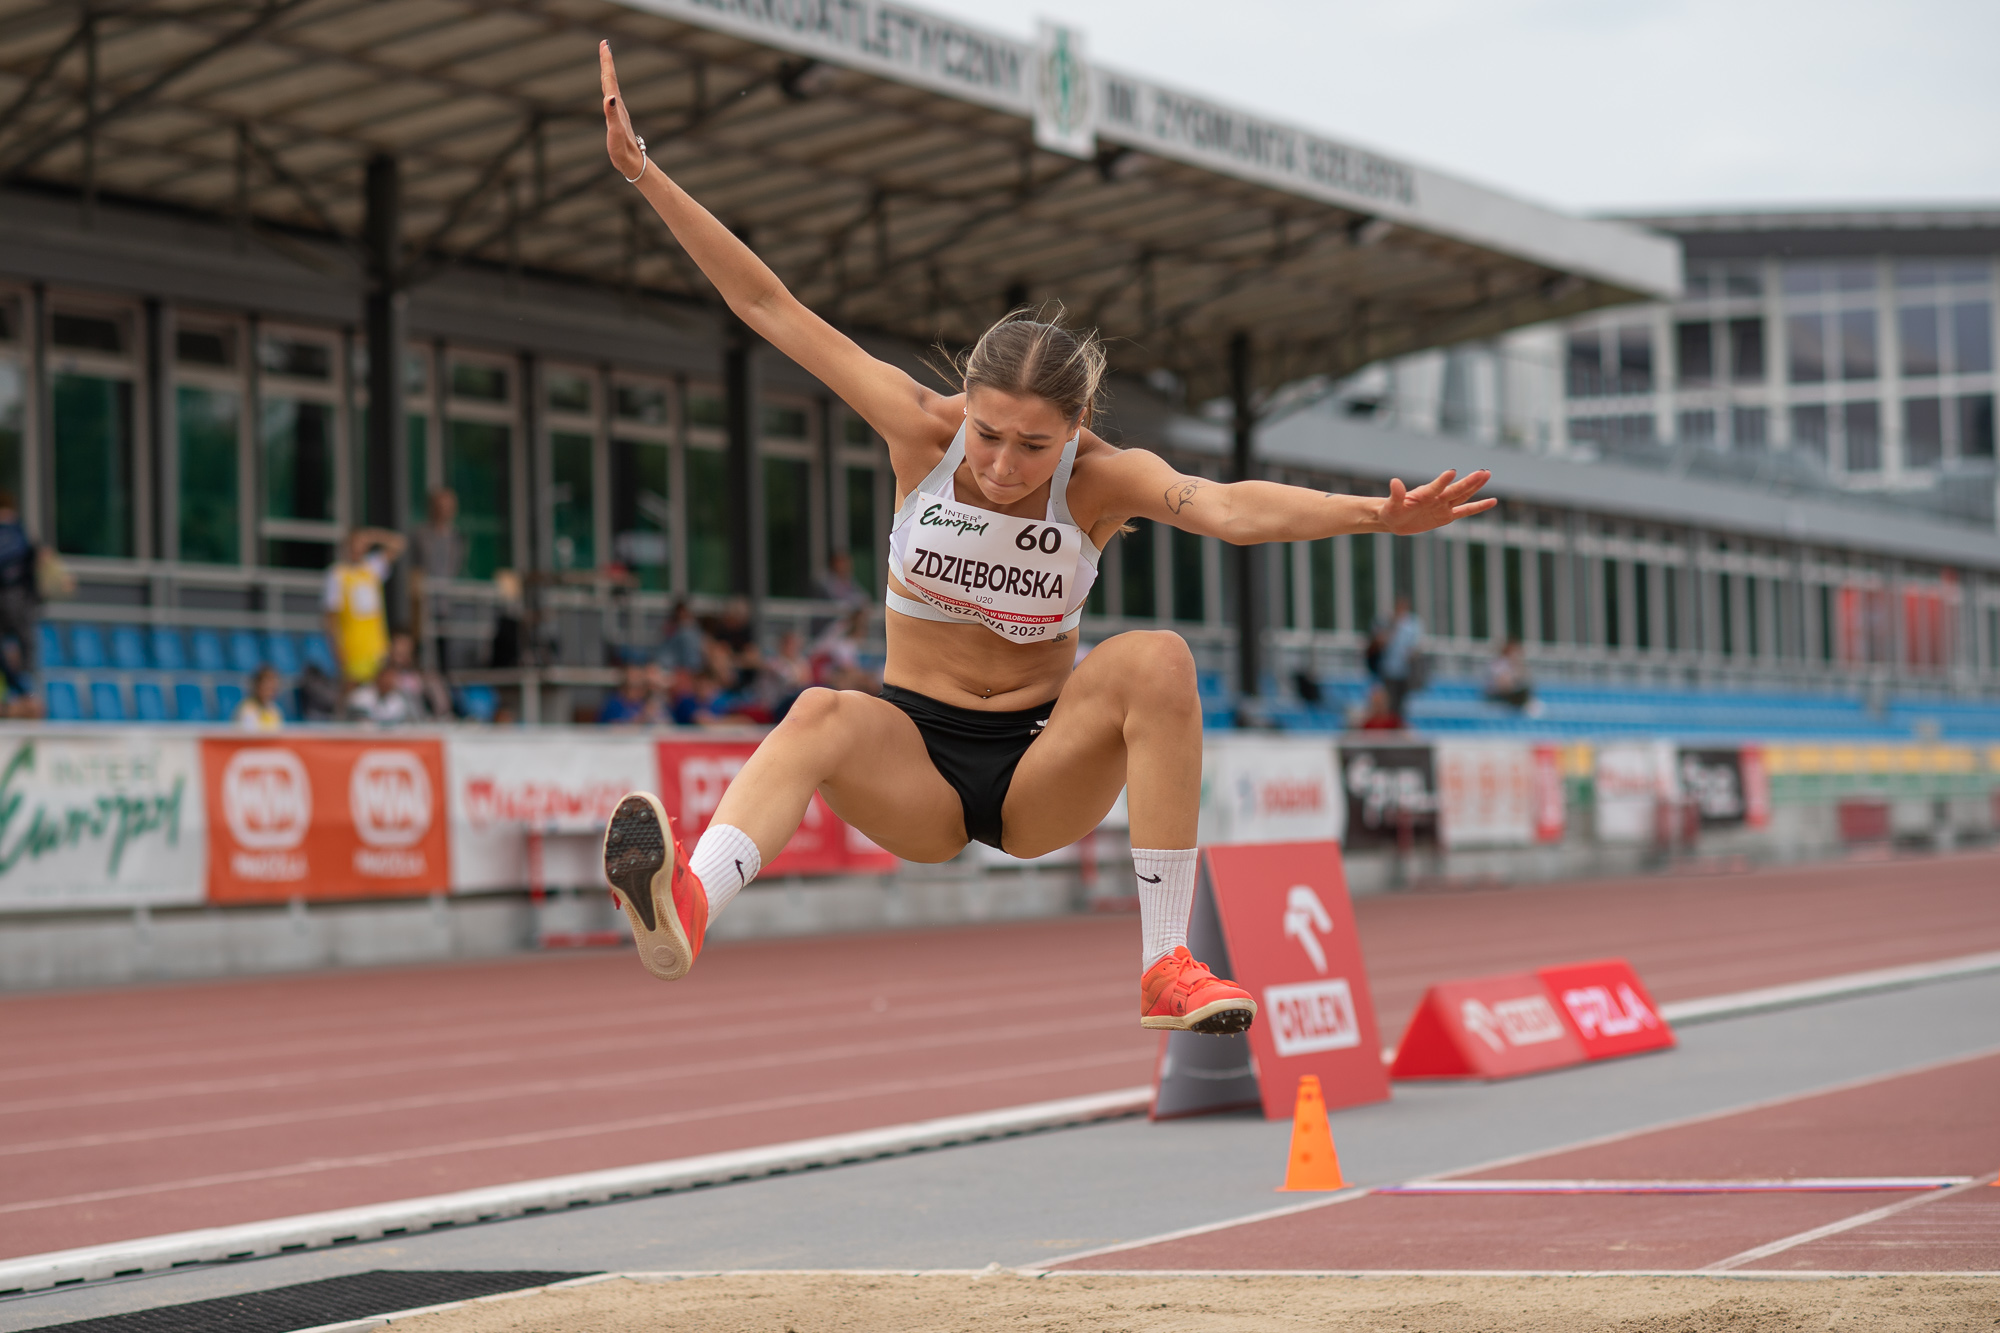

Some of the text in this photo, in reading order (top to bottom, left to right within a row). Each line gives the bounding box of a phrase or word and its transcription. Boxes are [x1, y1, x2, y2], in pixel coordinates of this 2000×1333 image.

[919, 503, 990, 537] Europol
[1015, 524, 1062, 554] 60
[911, 547, 1064, 599] ZDZIĘBORSKA
[920, 591, 1006, 633] WARSZAWA
[1009, 625, 1046, 637] 2023
[927, 590, 970, 608] MISTRZOSTWA
[969, 603, 990, 615] POLSKI
[998, 612, 1042, 623] WIELOBOJACH
[975, 595, 994, 605] U20
